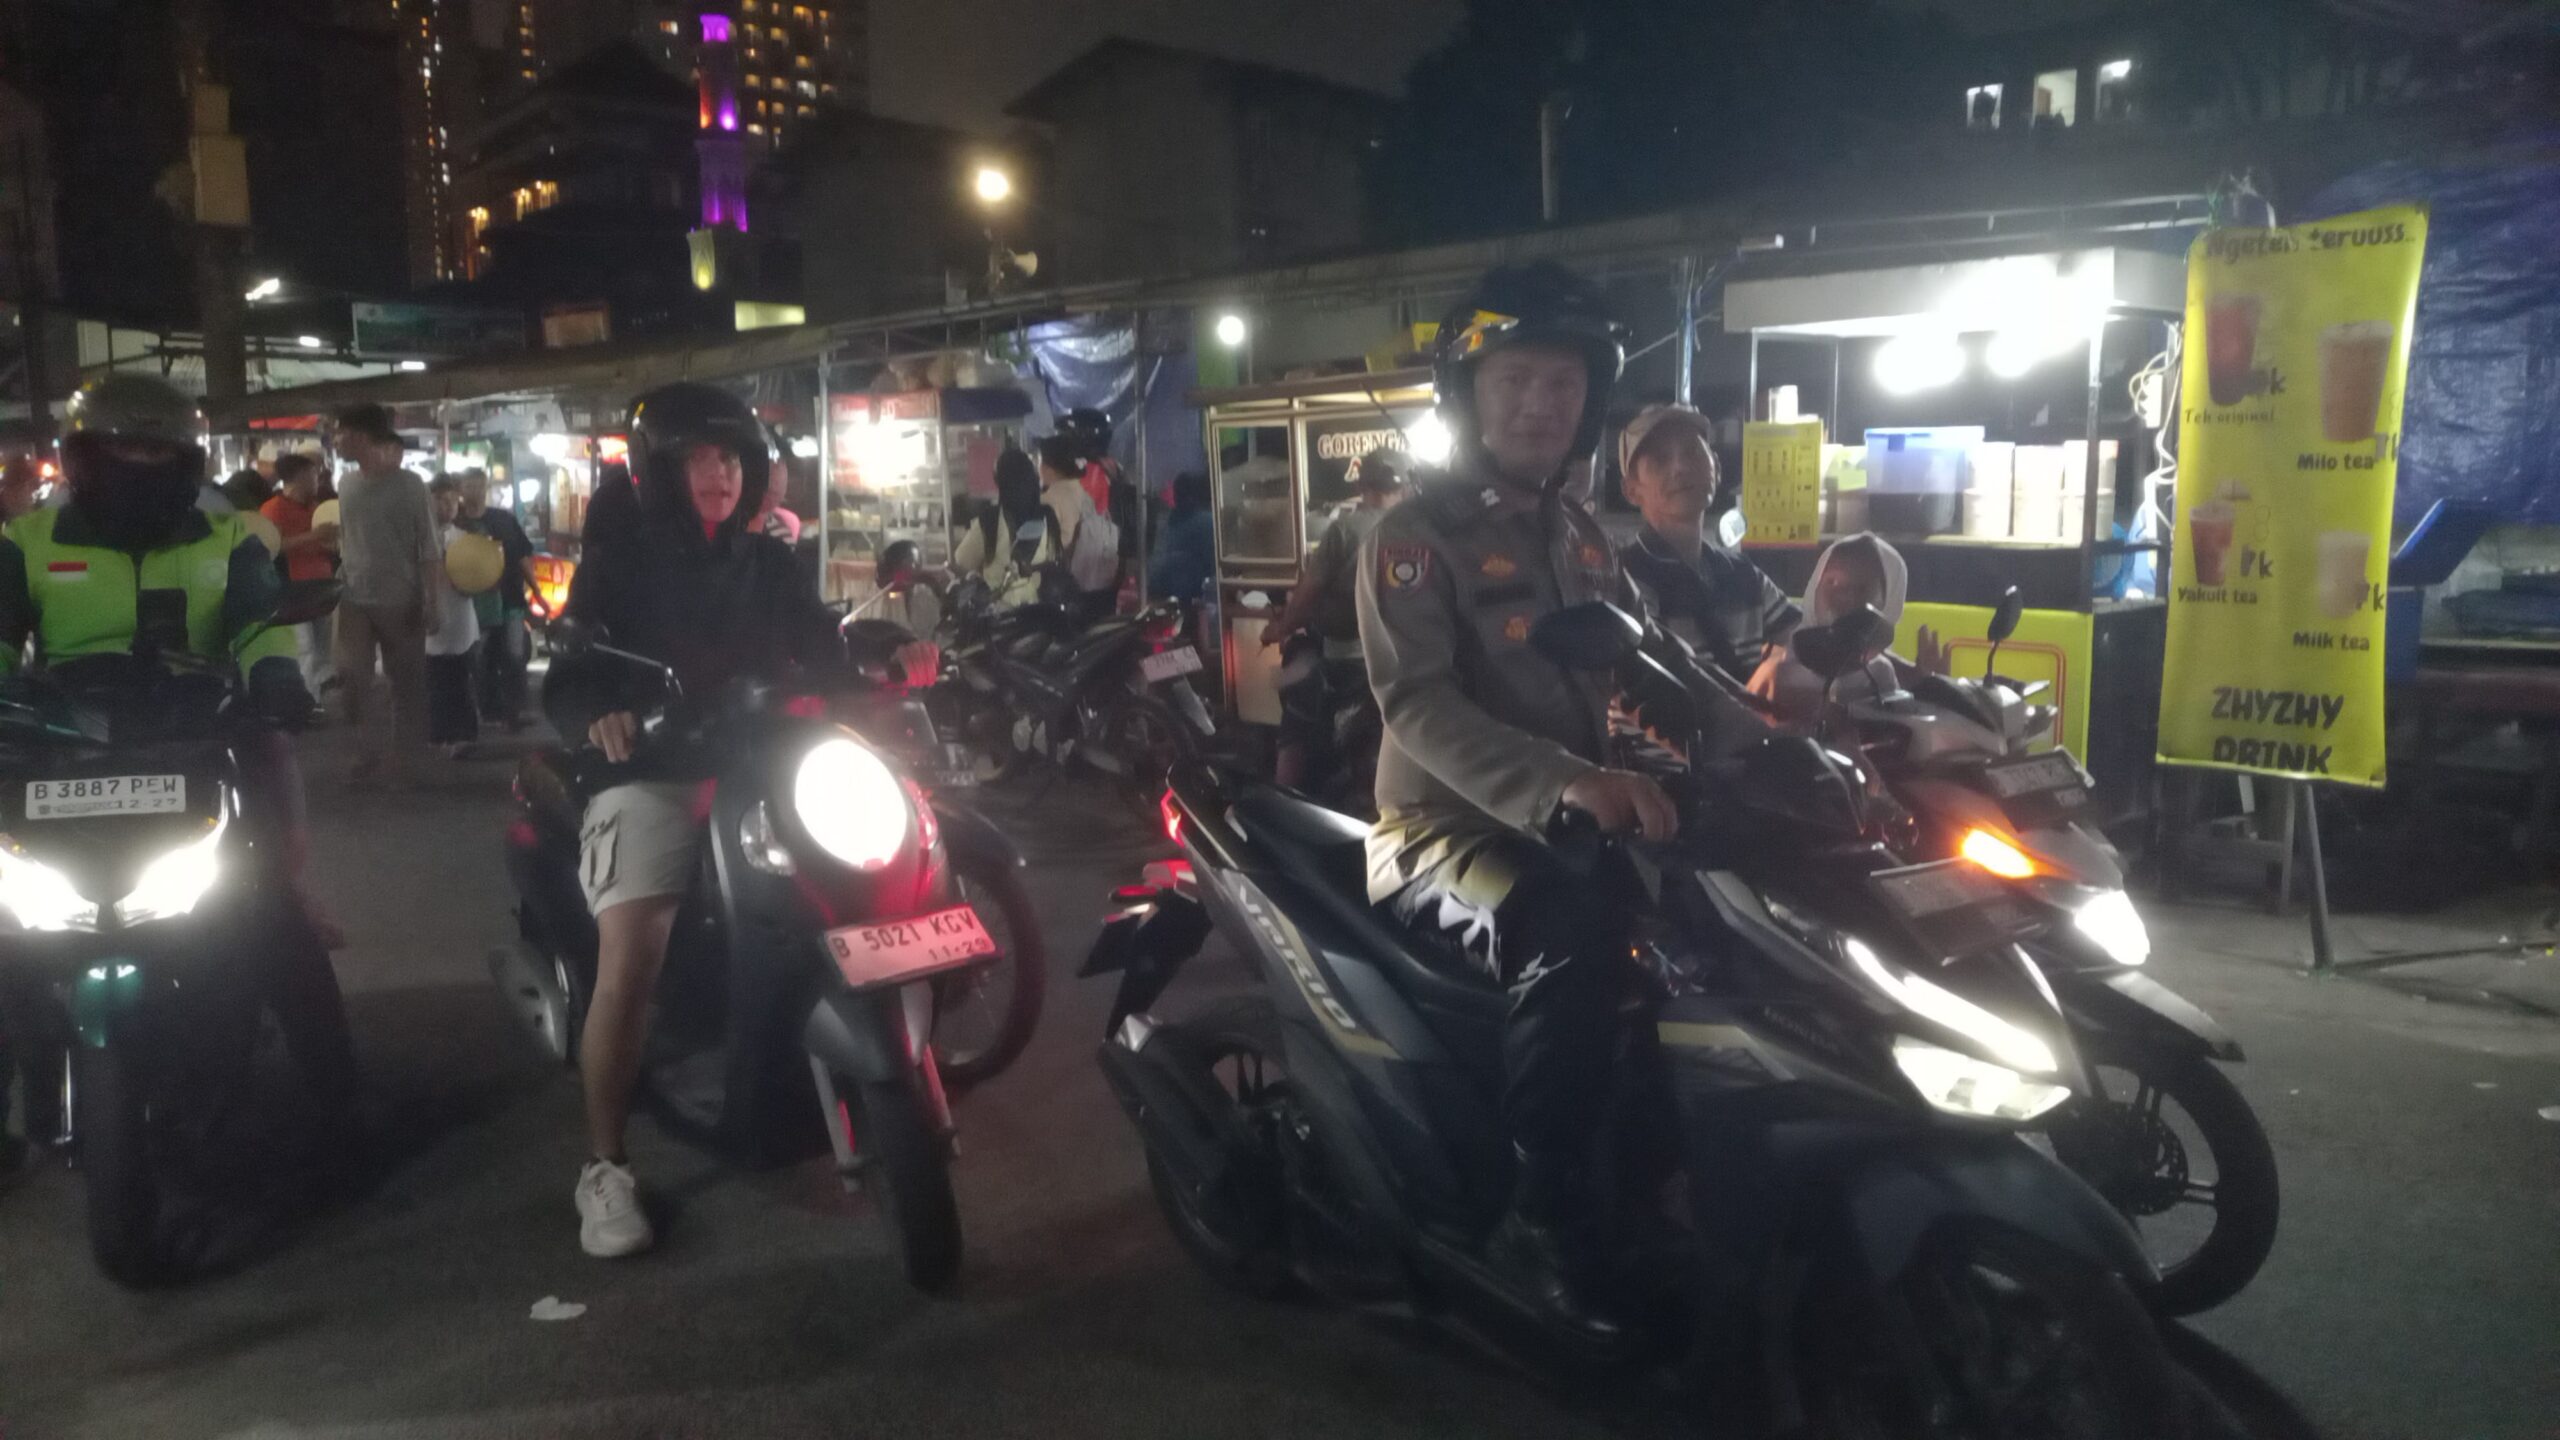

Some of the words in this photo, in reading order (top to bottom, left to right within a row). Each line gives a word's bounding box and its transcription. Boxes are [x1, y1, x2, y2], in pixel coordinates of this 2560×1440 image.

[2297, 453, 2338, 471] Milo
[2343, 453, 2375, 471] tea
[2233, 588, 2259, 605] tea
[2292, 631, 2334, 650] Milk
[2340, 633, 2371, 651] tea
[2211, 686, 2345, 731] ZHYZHY
[34, 784, 49, 800] B
[57, 779, 121, 799] 3887
[130, 777, 177, 794] PEW
[831, 936, 852, 959] B
[862, 922, 922, 951] 5021
